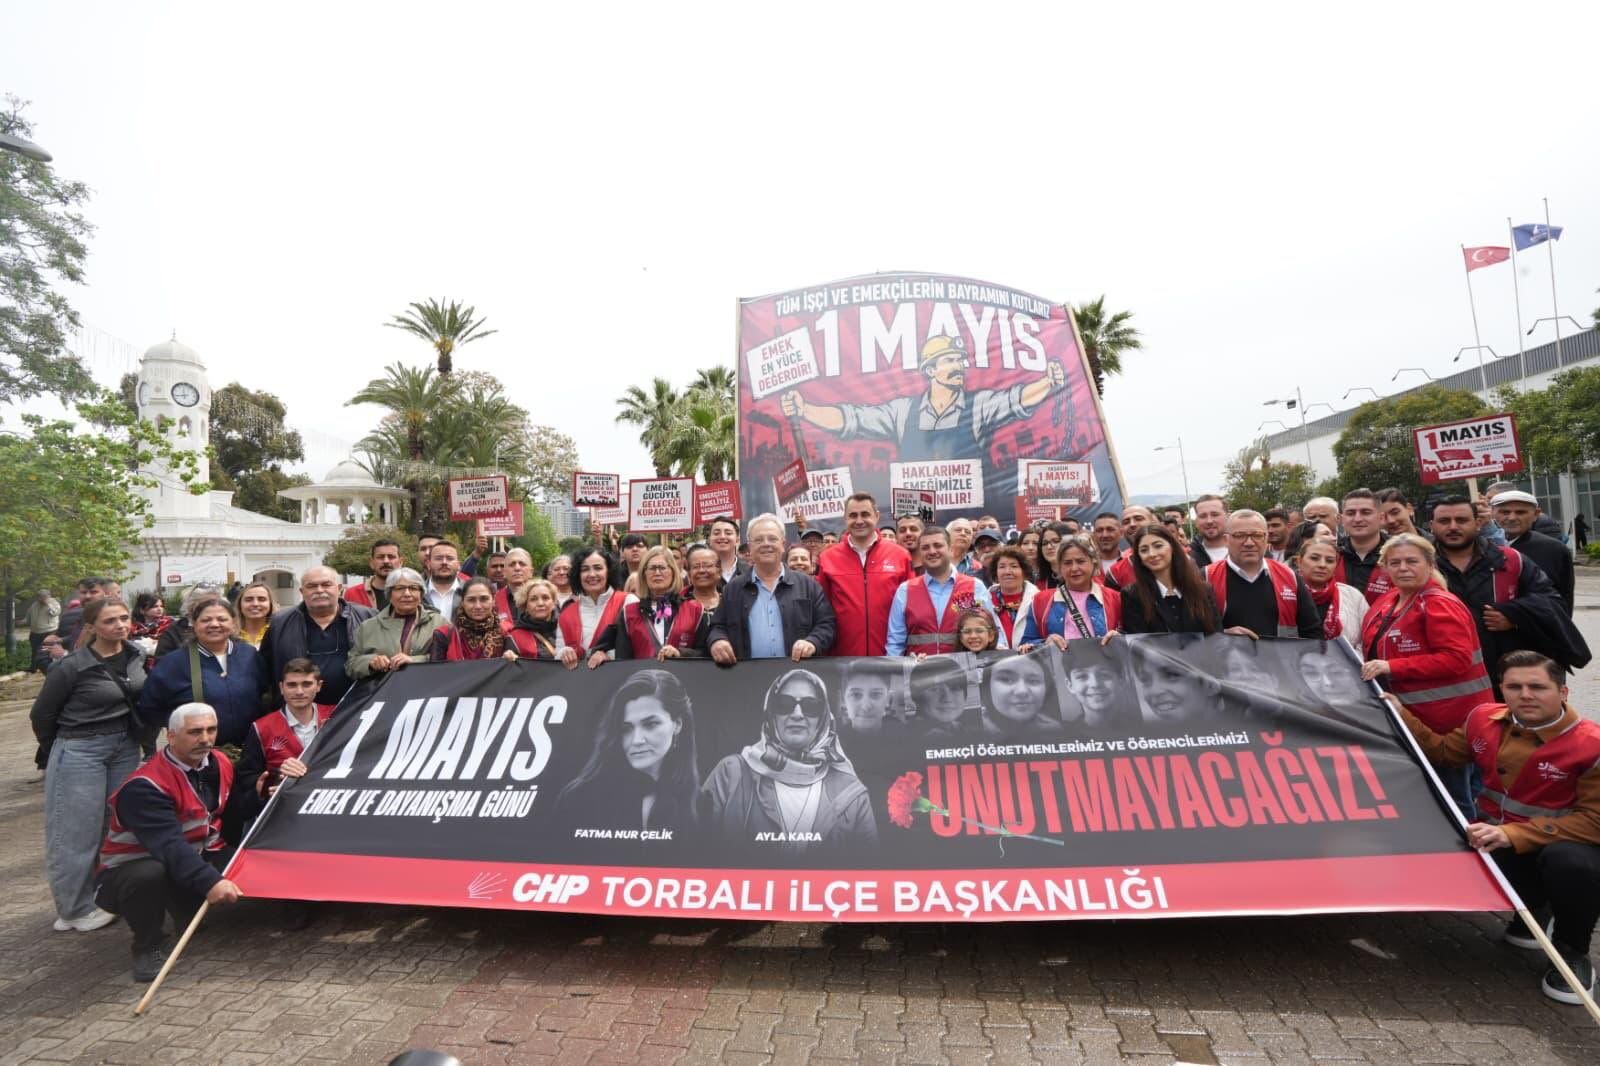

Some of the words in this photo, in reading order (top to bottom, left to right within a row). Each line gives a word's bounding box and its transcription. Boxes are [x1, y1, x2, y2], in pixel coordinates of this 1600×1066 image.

[776, 295, 800, 316] TÜM
[803, 287, 828, 312] İŞÇİ
[831, 287, 849, 305] VE
[851, 279, 946, 303] EMEKÇİLERİN
[948, 282, 1010, 306] BAYRAMINI
[1011, 292, 1051, 319] KUTLARIZ
[761, 336, 794, 361] EMEK
[815, 310, 841, 377] 1
[859, 302, 1048, 373] MAYIS
[761, 361, 775, 376] EN
[775, 349, 804, 369] YÜCE
[758, 360, 812, 392] DEĞERDİR!
[1424, 432, 1439, 450] 1
[1440, 421, 1506, 443] MAYIS
[902, 464, 972, 479] HAKLARIMIZ
[903, 477, 973, 491] EMEĞİMİZLE
[1045, 472, 1079, 480] MAYIS!
[643, 490, 681, 500] GÜCÜYLE
[645, 483, 678, 492] EMEĞİN
[811, 486, 845, 502] GÜÇLÜ
[937, 493, 971, 505] NILIR!
[637, 507, 686, 517] KURACAĞIZ!
[323, 701, 384, 779] 1
[367, 695, 568, 781] MAYIS
[925, 746, 974, 760] EMEKÇİ
[976, 739, 1104, 757] ÖĞRETMENLERİMİZ
[1106, 741, 1125, 751] VE
[1127, 731, 1249, 750] ÖĞRENCİLERİMİZİ
[927, 730, 1398, 838] UNUTMAYACAĞIZ!
[298, 788, 354, 815] EMEK
[350, 789, 375, 815] VE
[374, 790, 481, 823] DAYANIŞMA
[478, 785, 538, 818] GÜNÜ
[574, 828, 612, 840] FATMA
[614, 829, 639, 840] NUR
[640, 828, 673, 841] ÇELİK
[755, 831, 786, 842] AYLA
[788, 832, 822, 842] KARA
[512, 873, 590, 906] CHP
[601, 876, 774, 911] TORBALI
[893, 869, 1169, 918] BAŞKANLIĞI
